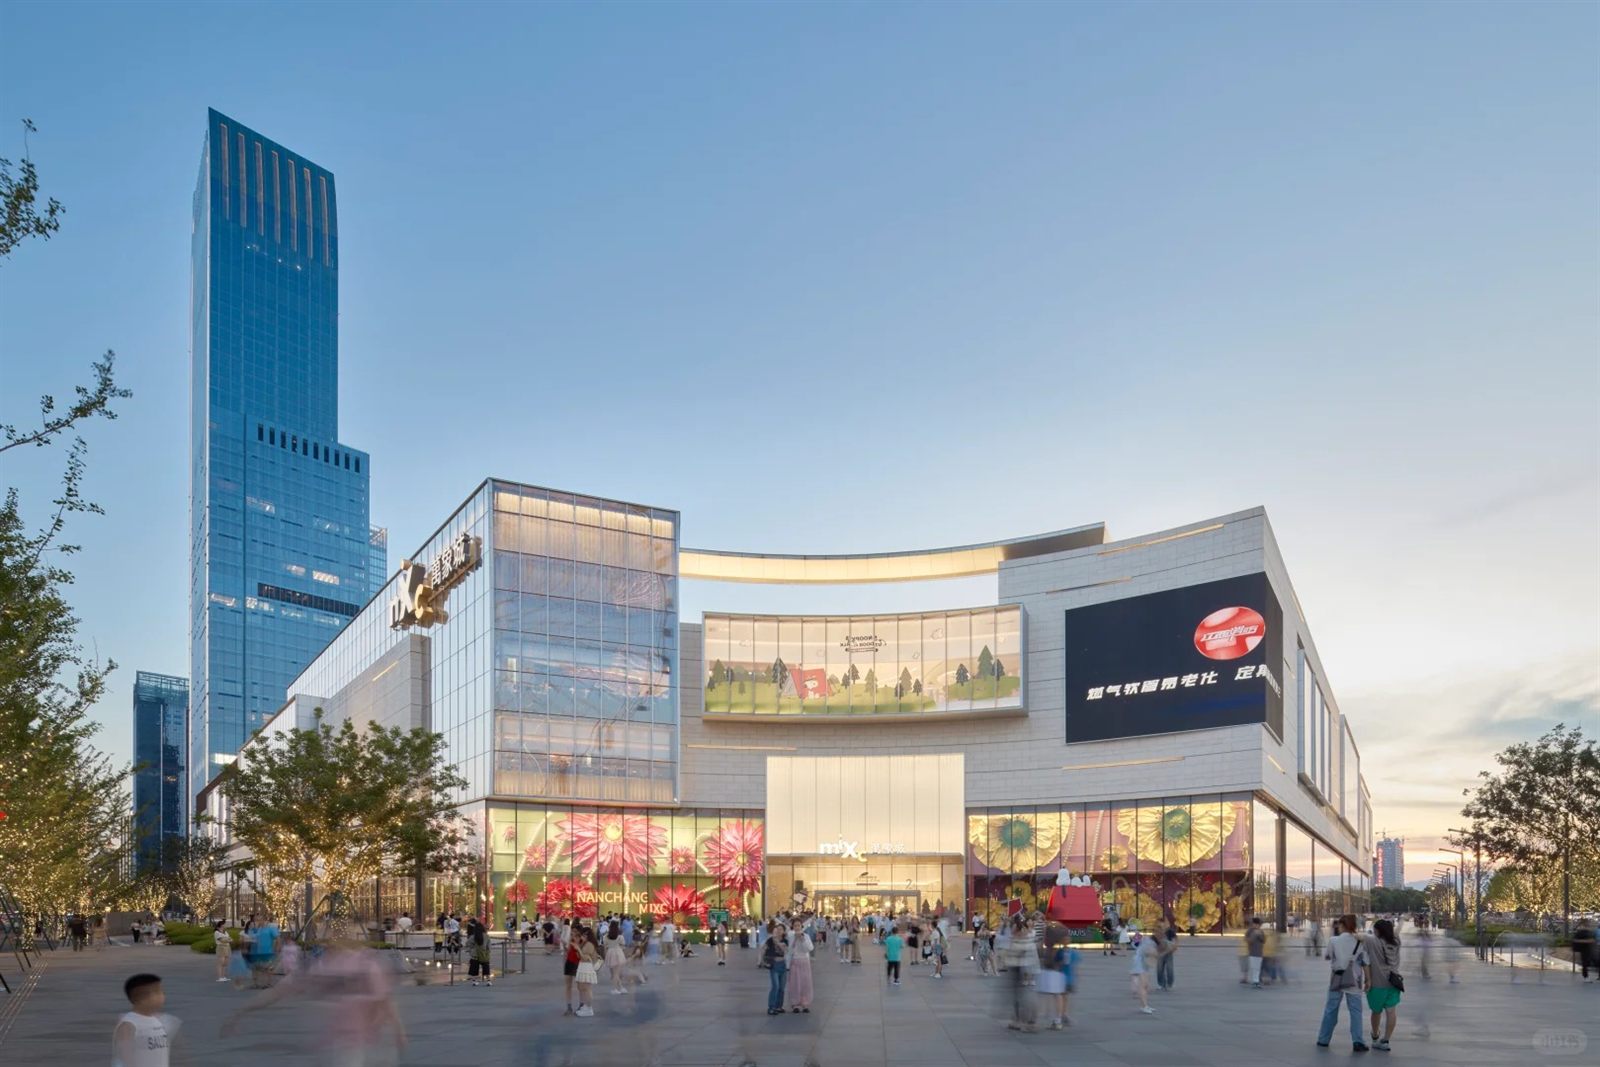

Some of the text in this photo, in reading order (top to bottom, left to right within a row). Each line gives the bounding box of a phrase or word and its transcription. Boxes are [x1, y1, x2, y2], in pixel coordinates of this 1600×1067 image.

[904, 878, 912, 890] 2
[576, 891, 648, 903] NANCHANG
[638, 903, 669, 915] MIXC
